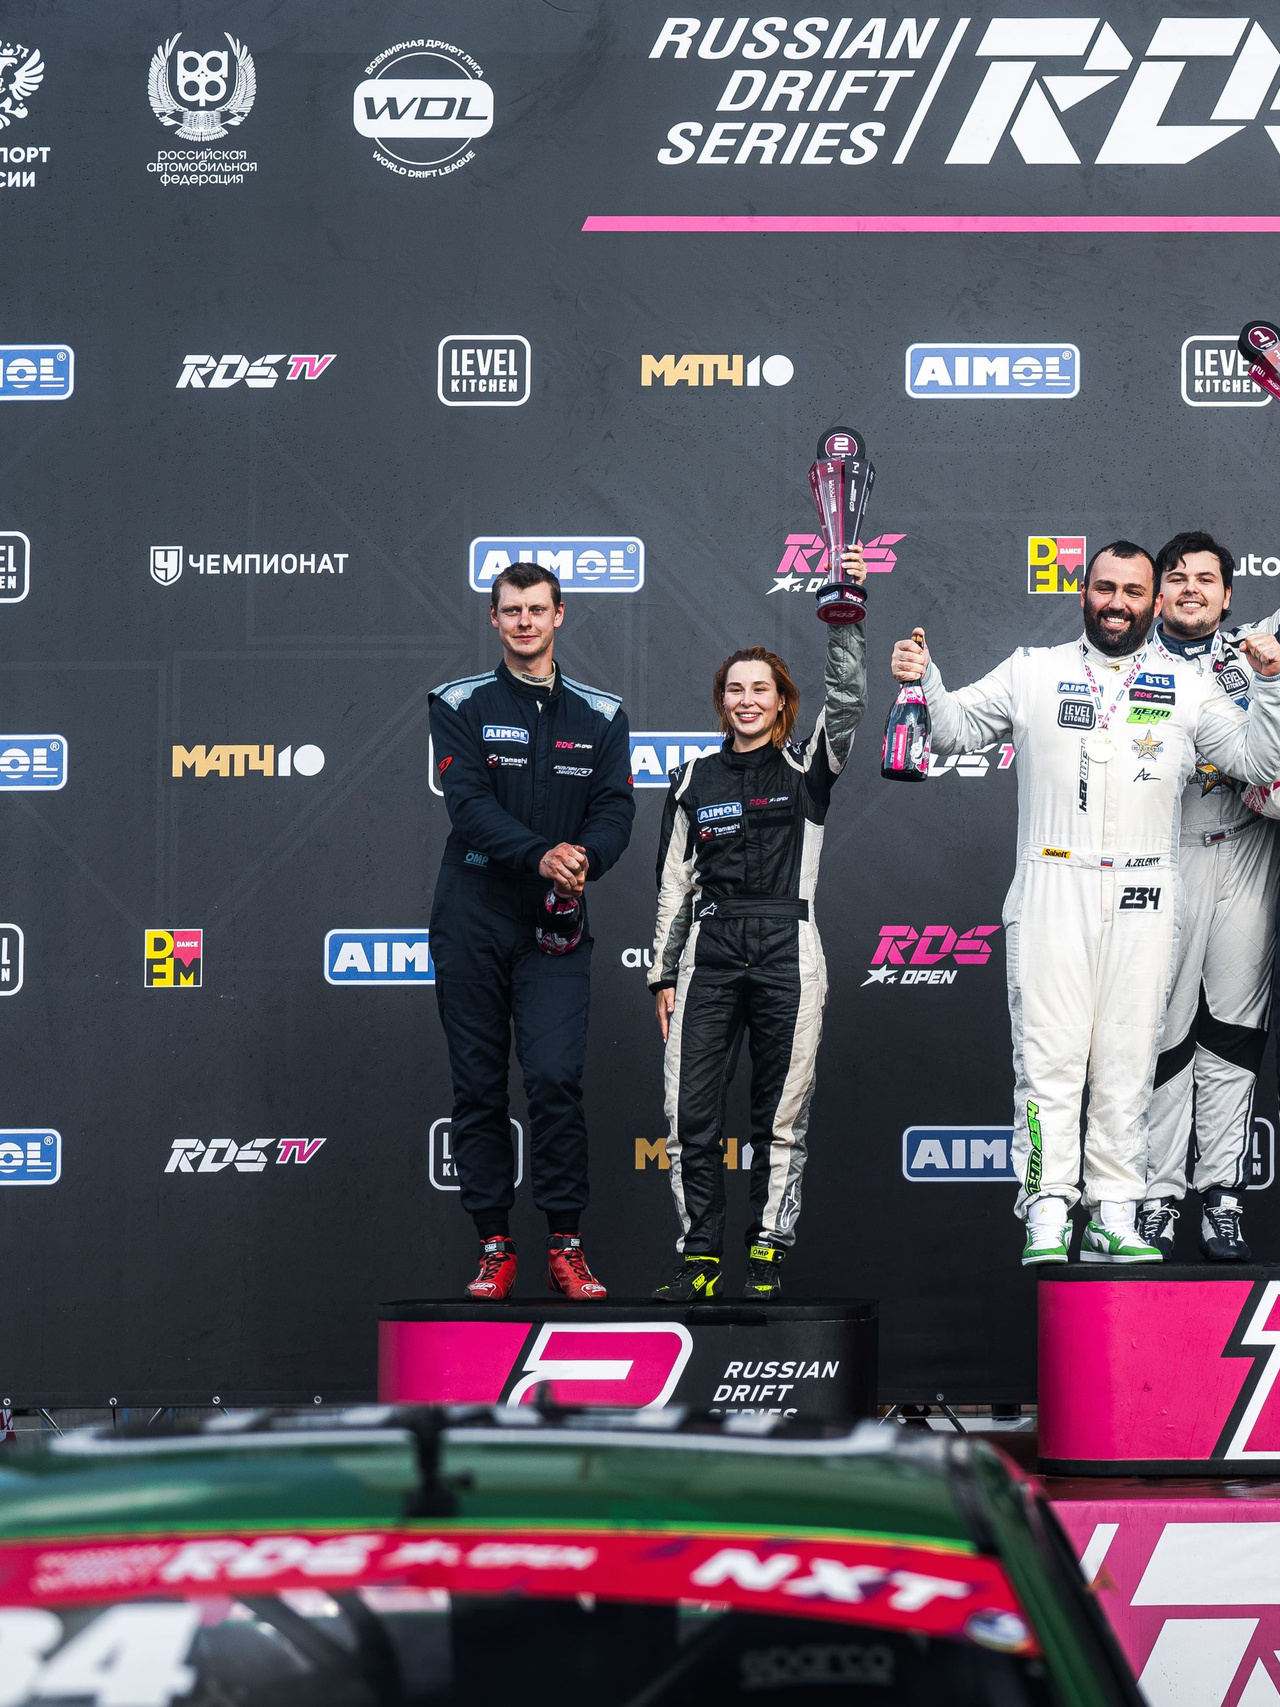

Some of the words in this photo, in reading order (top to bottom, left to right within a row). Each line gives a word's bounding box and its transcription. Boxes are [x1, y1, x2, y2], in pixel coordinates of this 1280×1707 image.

[649, 17, 939, 60] RUSSIAN
[365, 39, 425, 75] ВСЕМИРНАЯ
[425, 39, 465, 57] ДРИФТ
[462, 54, 484, 78] ЛИГА
[716, 70, 915, 112] DRIFT
[364, 97, 488, 120] WDL
[658, 122, 885, 165] SERIES
[157, 148, 247, 161] российская
[372, 151, 407, 176] WORLD
[408, 169, 437, 178] DRIFT
[438, 150, 476, 176] LEAGUE
[146, 160, 258, 173] автомобильная
[160, 172, 244, 186] федерация
[176, 355, 284, 388] RDS
[286, 354, 337, 381] TV
[452, 349, 517, 375] LEVEL
[914, 356, 1071, 386] AIMOL
[1194, 349, 1250, 376] LEVE
[452, 379, 517, 392] KITCHEN
[189, 554, 348, 574] ЧЕМПИОНАТ
[1145, 675, 1170, 686] ВТБ
[1065, 704, 1091, 718] LEVEL
[485, 728, 527, 742] AIMOL
[700, 805, 740, 820] AIMOL
[465, 853, 489, 865] OMP
[1119, 887, 1161, 910] 234
[871, 926, 1000, 964] RDS
[900, 970, 957, 984] OPEN
[164, 1139, 275, 1172] RDS
[276, 1138, 327, 1165] TV
[753, 1248, 769, 1257] OMP
[724, 1361, 839, 1378] RUSSIAN
[713, 1385, 794, 1401] DRIFT
[691, 1548, 971, 1612] NXT
